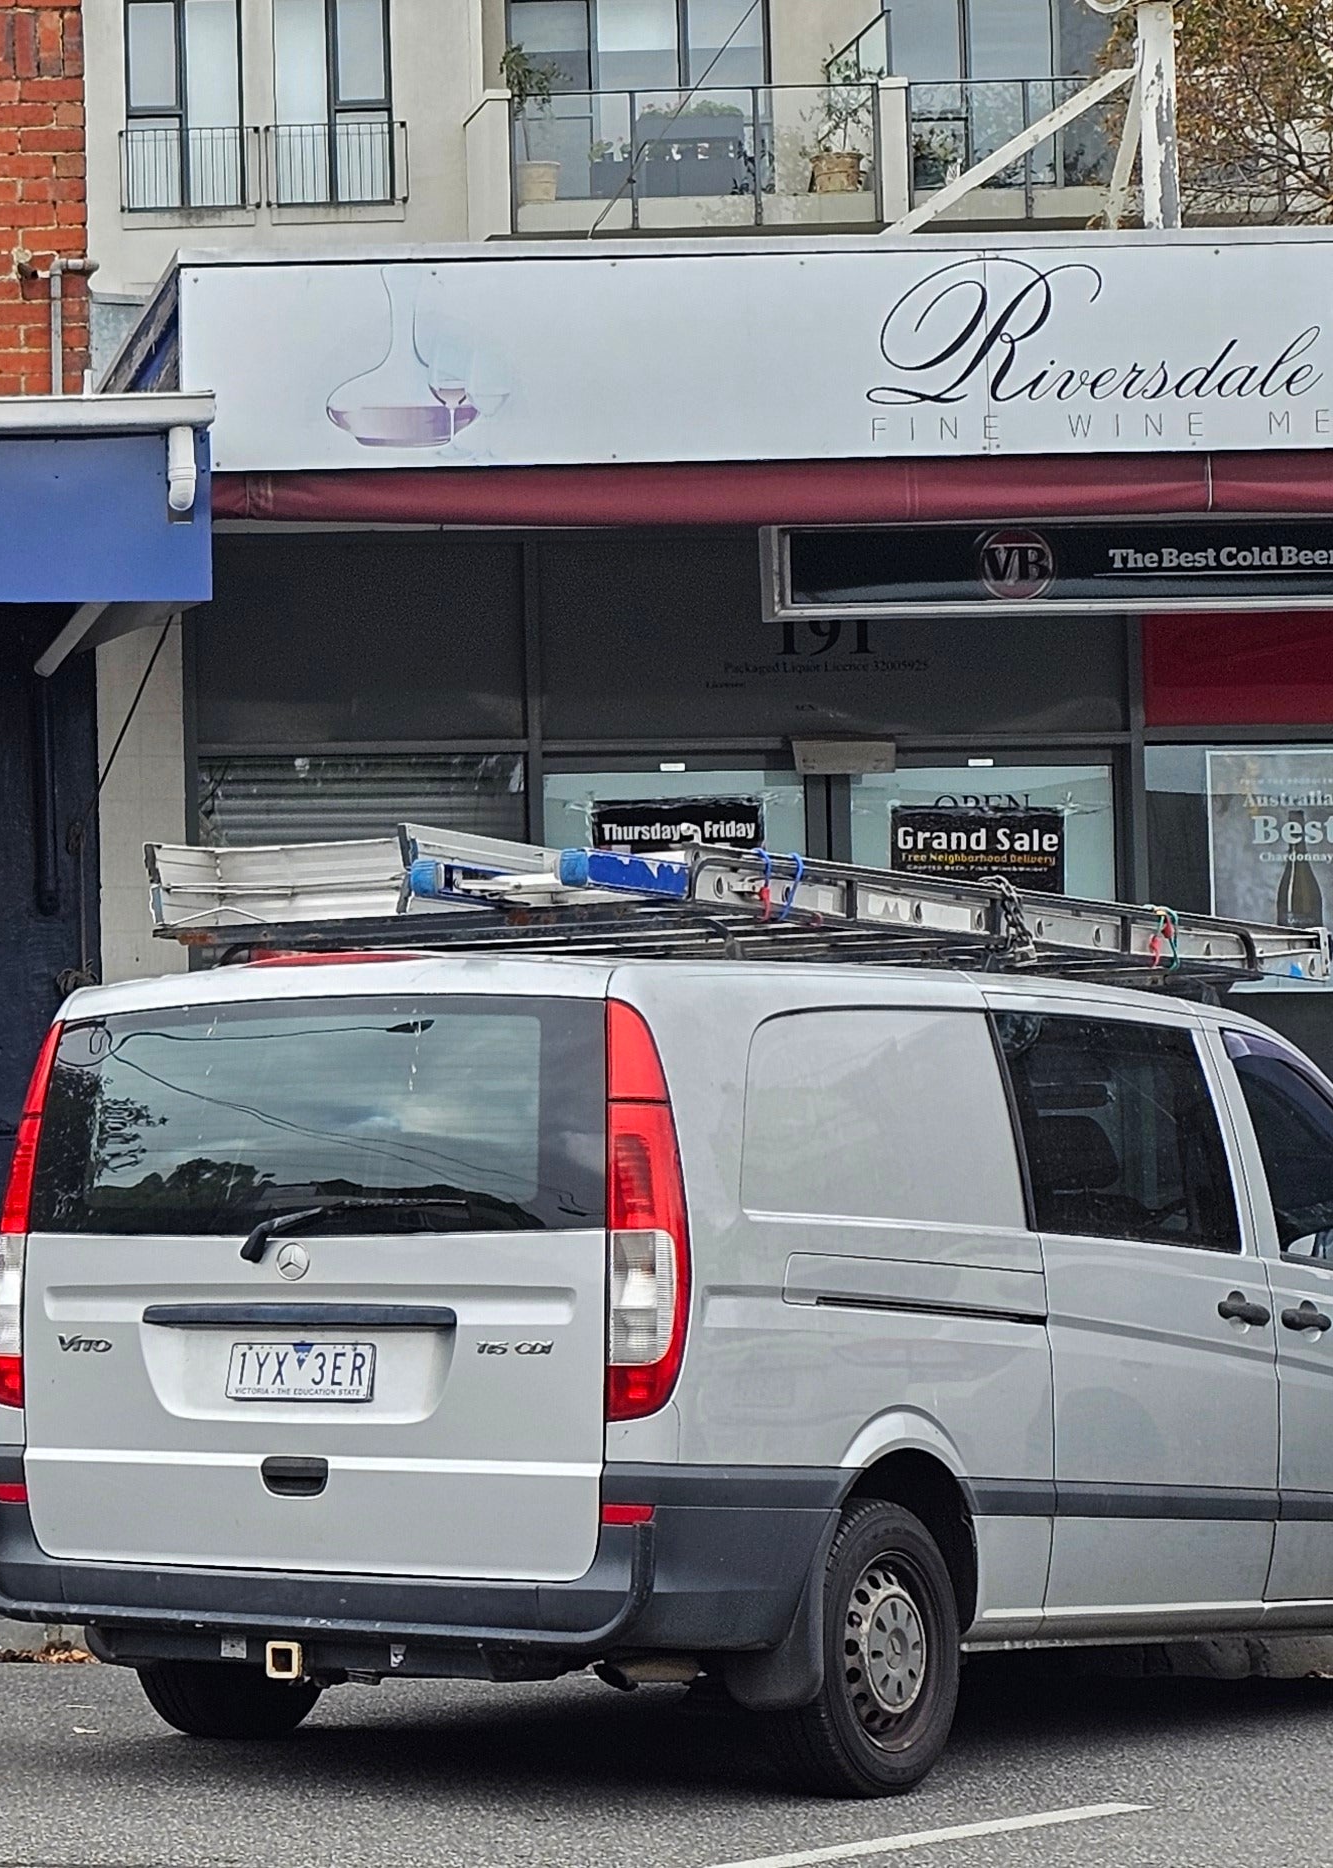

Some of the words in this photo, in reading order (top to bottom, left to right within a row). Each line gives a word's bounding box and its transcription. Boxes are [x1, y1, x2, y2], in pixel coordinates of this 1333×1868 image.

[867, 257, 1323, 405] Riversdale
[872, 415, 1000, 442] FINE
[1068, 411, 1204, 438] WINE
[982, 543, 1054, 587] VB
[1109, 548, 1160, 571] The
[1162, 547, 1217, 568] Best
[1219, 546, 1279, 567] Cold
[1280, 545, 1333, 567] Bee
[601, 821, 683, 842] Thursday
[703, 820, 757, 840] Friday
[897, 826, 987, 851] Grand
[995, 827, 1059, 852] Sale
[902, 853, 927, 863] Free
[930, 852, 1008, 866] Neighborhood
[238, 1351, 290, 1386] 1YX
[310, 1351, 367, 1387] 3ER
[234, 1387, 269, 1396] VICTORIA
[277, 1387, 291, 1396] THE
[293, 1387, 336, 1397] EDUCATION
[338, 1388, 361, 1397] STATE
